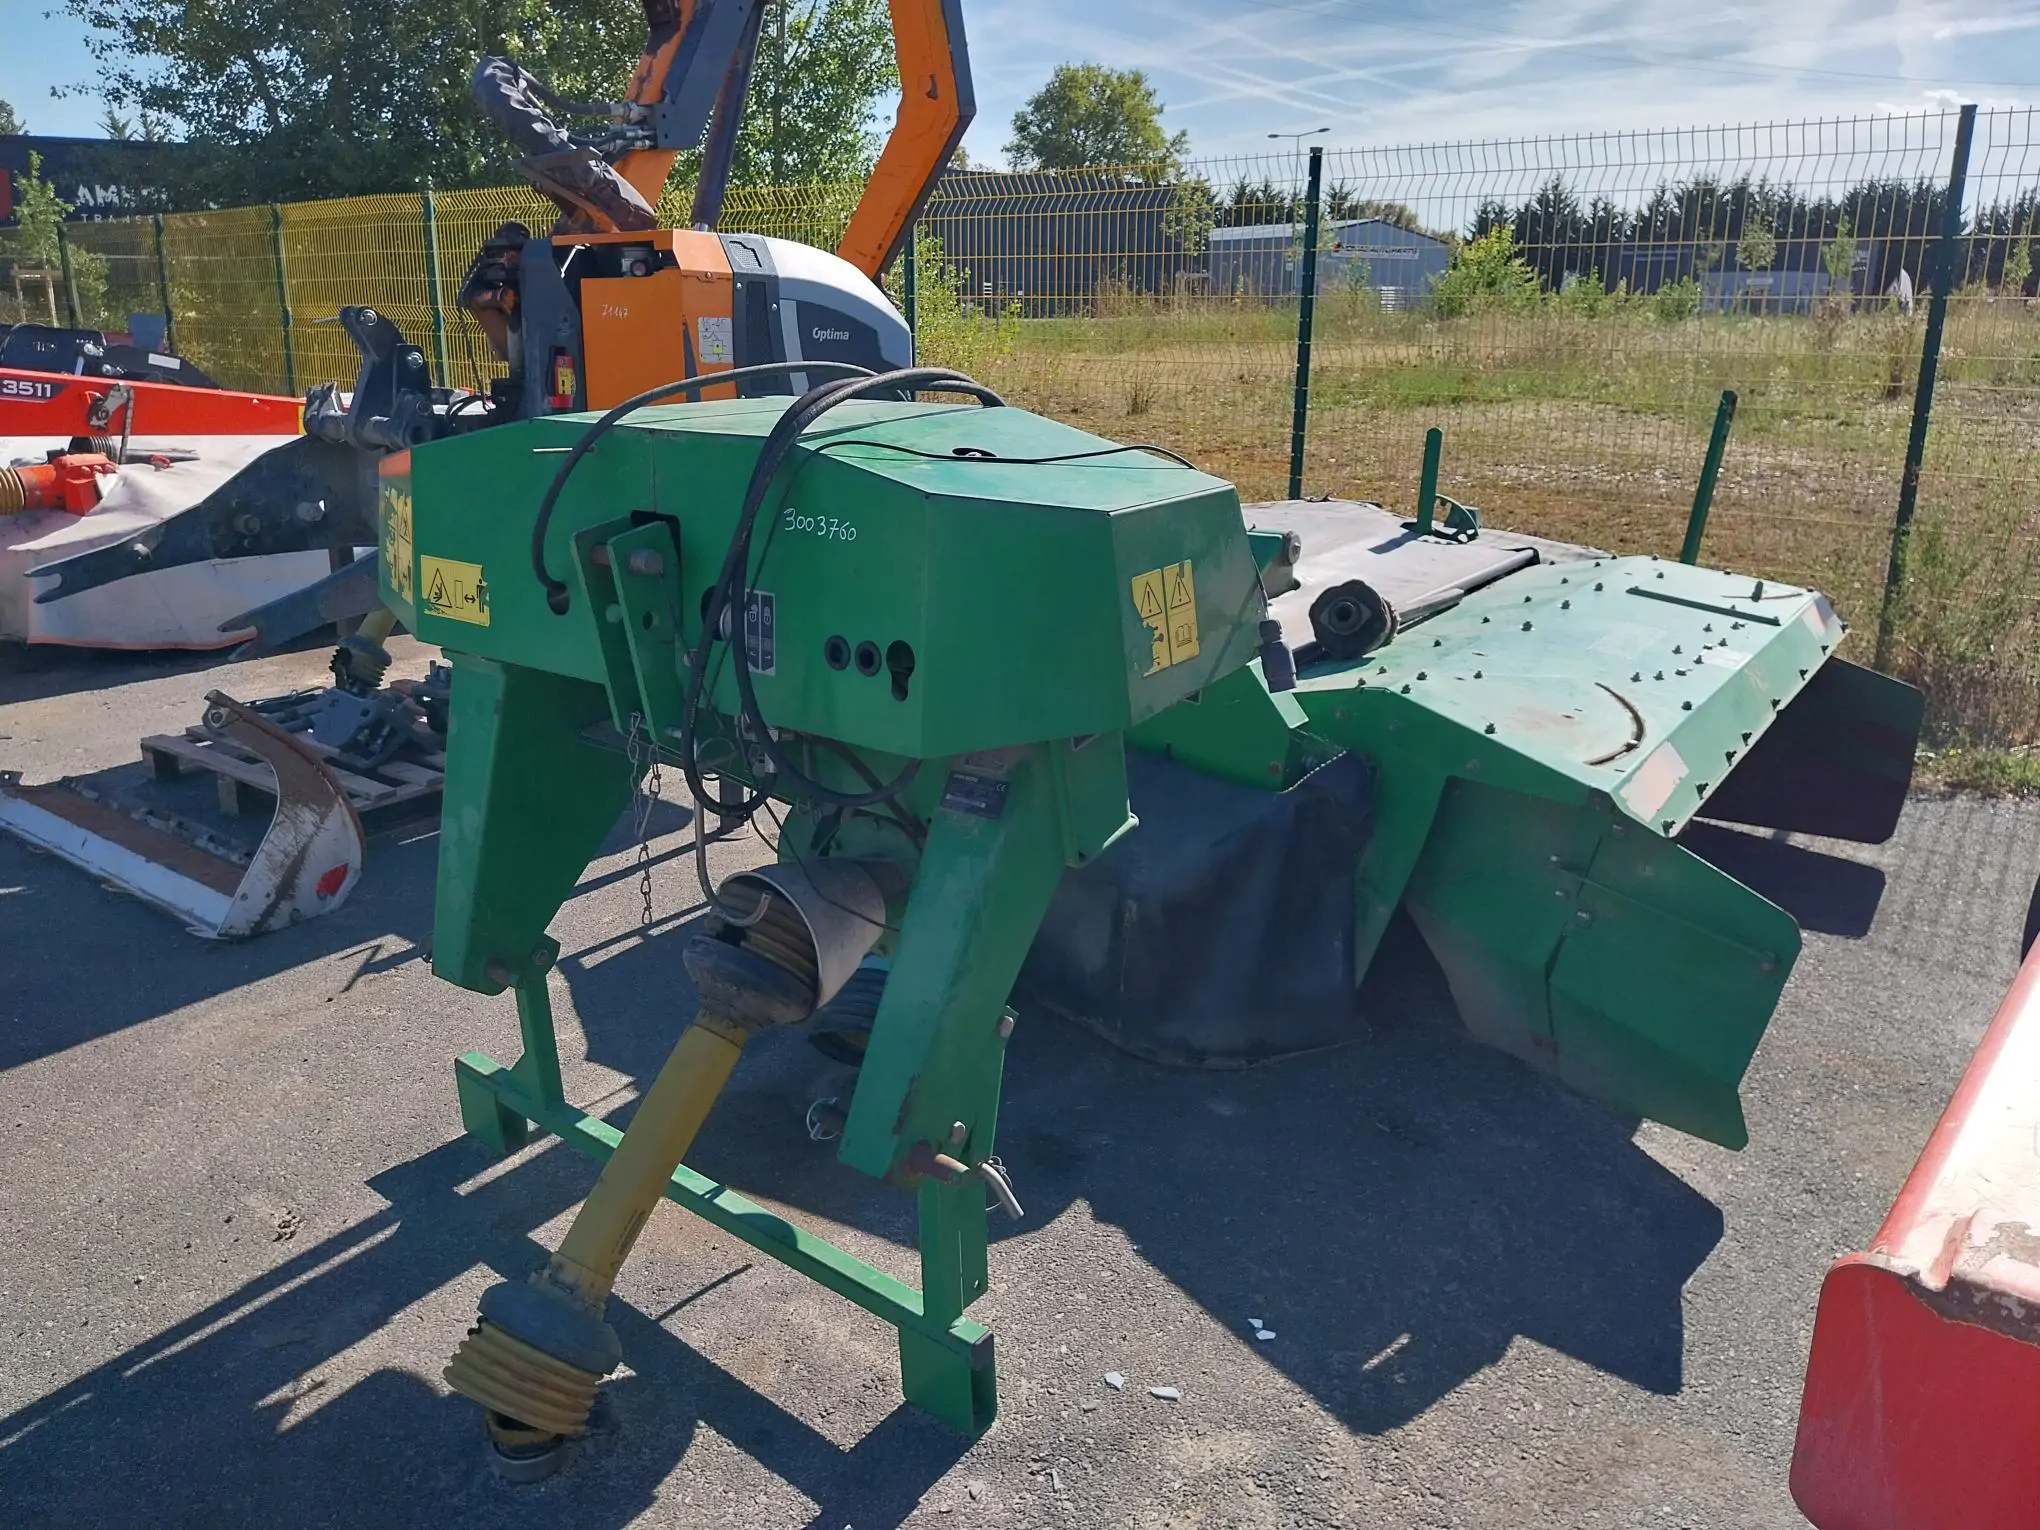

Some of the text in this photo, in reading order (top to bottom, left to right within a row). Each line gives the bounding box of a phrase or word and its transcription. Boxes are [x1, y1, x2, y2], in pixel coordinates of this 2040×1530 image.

[812, 327, 850, 342] Optima
[2, 379, 52, 398] 3511
[783, 507, 857, 541] 3003760
